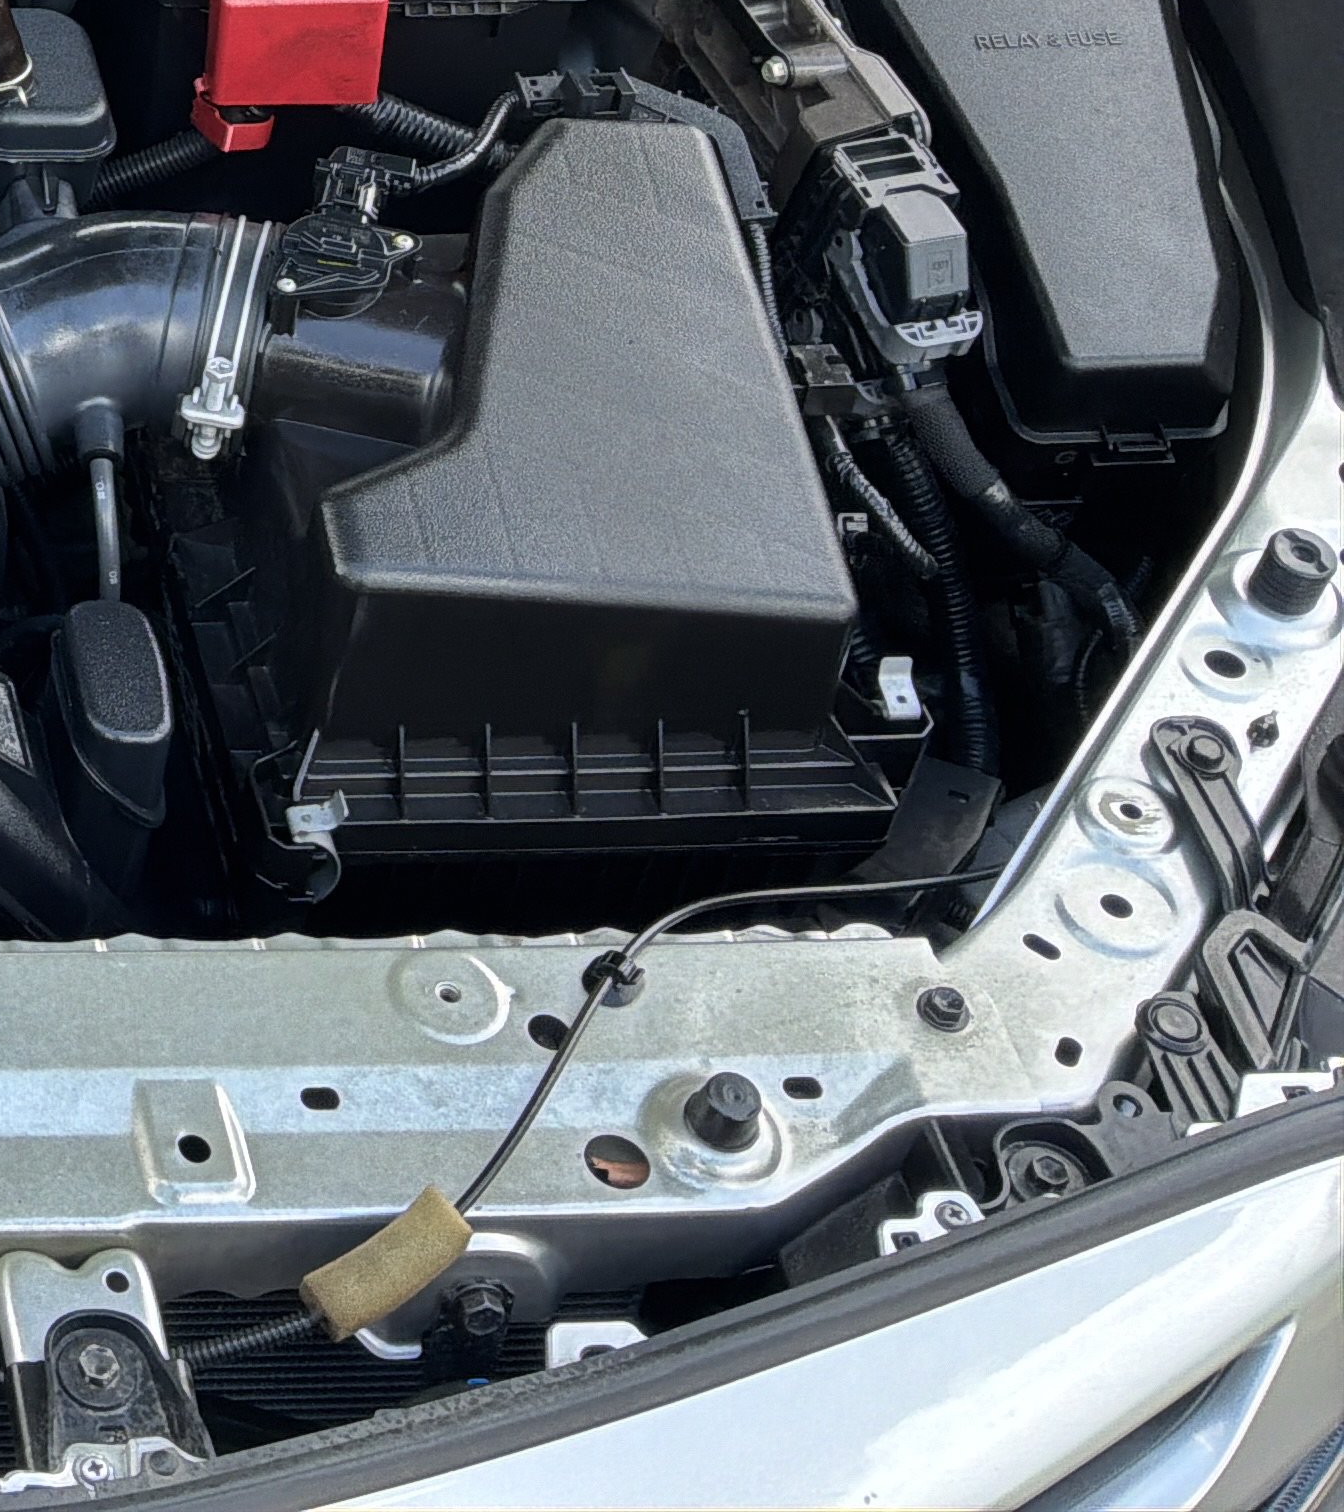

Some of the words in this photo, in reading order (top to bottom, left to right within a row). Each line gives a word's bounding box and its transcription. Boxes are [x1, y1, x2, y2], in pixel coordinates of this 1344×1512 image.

[974, 32, 1041, 51] RELAY
[1047, 33, 1060, 48] &
[1064, 30, 1123, 48] FUSE
